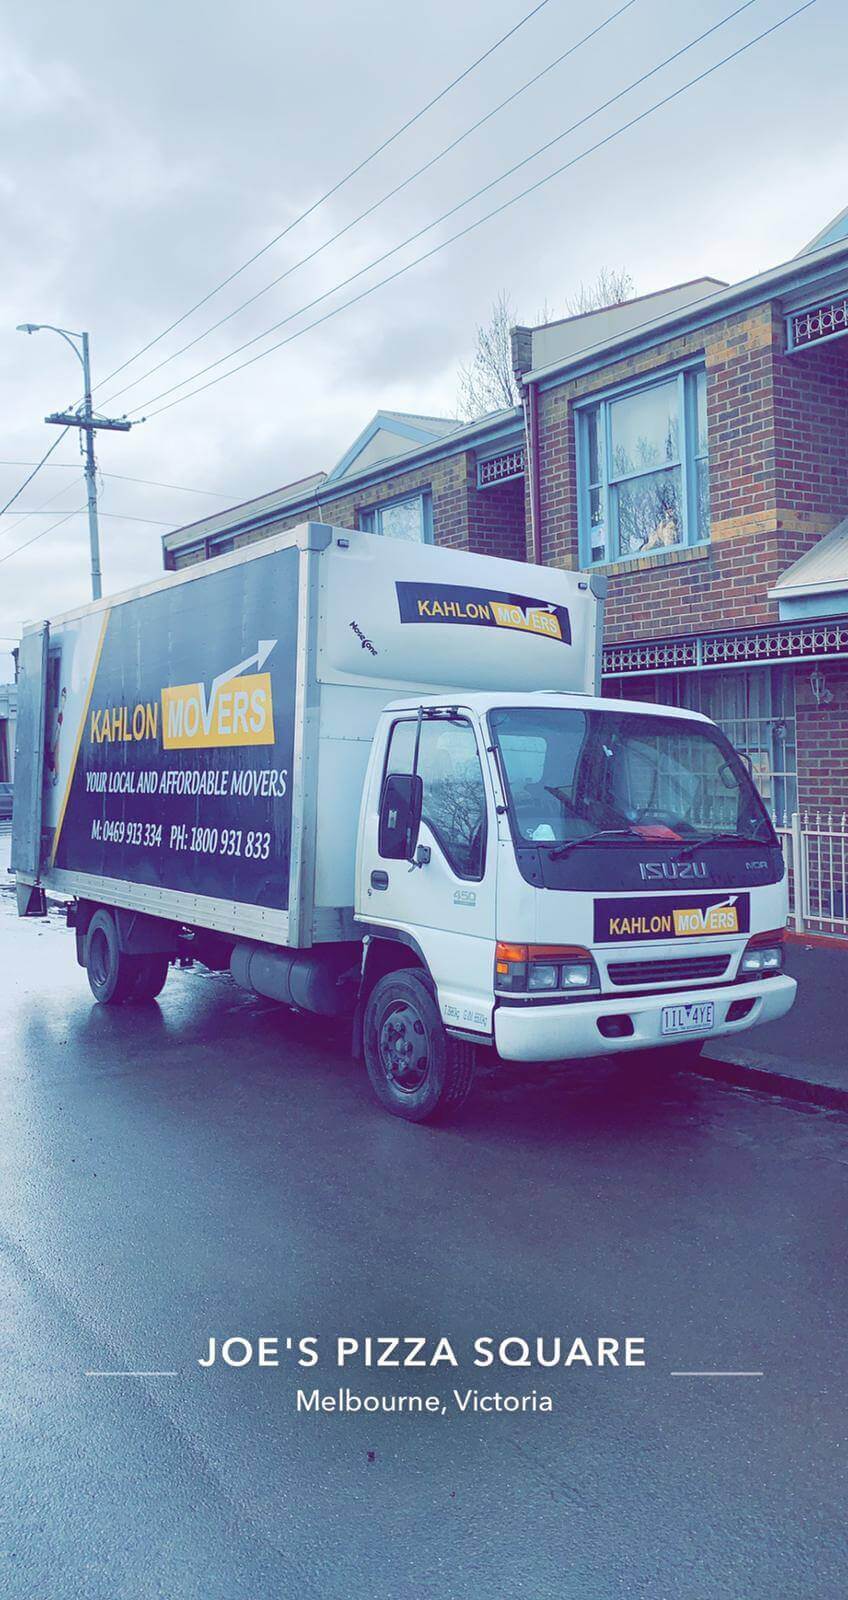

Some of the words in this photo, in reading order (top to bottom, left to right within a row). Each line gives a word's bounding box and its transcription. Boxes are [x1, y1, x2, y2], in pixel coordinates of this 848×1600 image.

[417, 599, 491, 621] KAHLON
[497, 606, 558, 634] MOVERS
[90, 702, 158, 743] KAHLON
[167, 681, 267, 739] MOVERS
[86, 771, 109, 792] YOUR
[109, 771, 135, 793] LOCAL
[136, 771, 158, 793] AND
[158, 770, 229, 796] AFFORDABLE
[230, 769, 287, 797] MOVERS
[91, 819, 102, 840] M:
[102, 820, 126, 843] 0469
[126, 822, 143, 846] 913
[143, 824, 162, 847] 334
[170, 825, 188, 851] PH:
[190, 826, 218, 854] 1800
[220, 829, 242, 857] 931
[244, 831, 271, 860] 833
[639, 862, 710, 880] ISUZU
[609, 915, 671, 936] KAHLON
[678, 908, 735, 932] MOVERS
